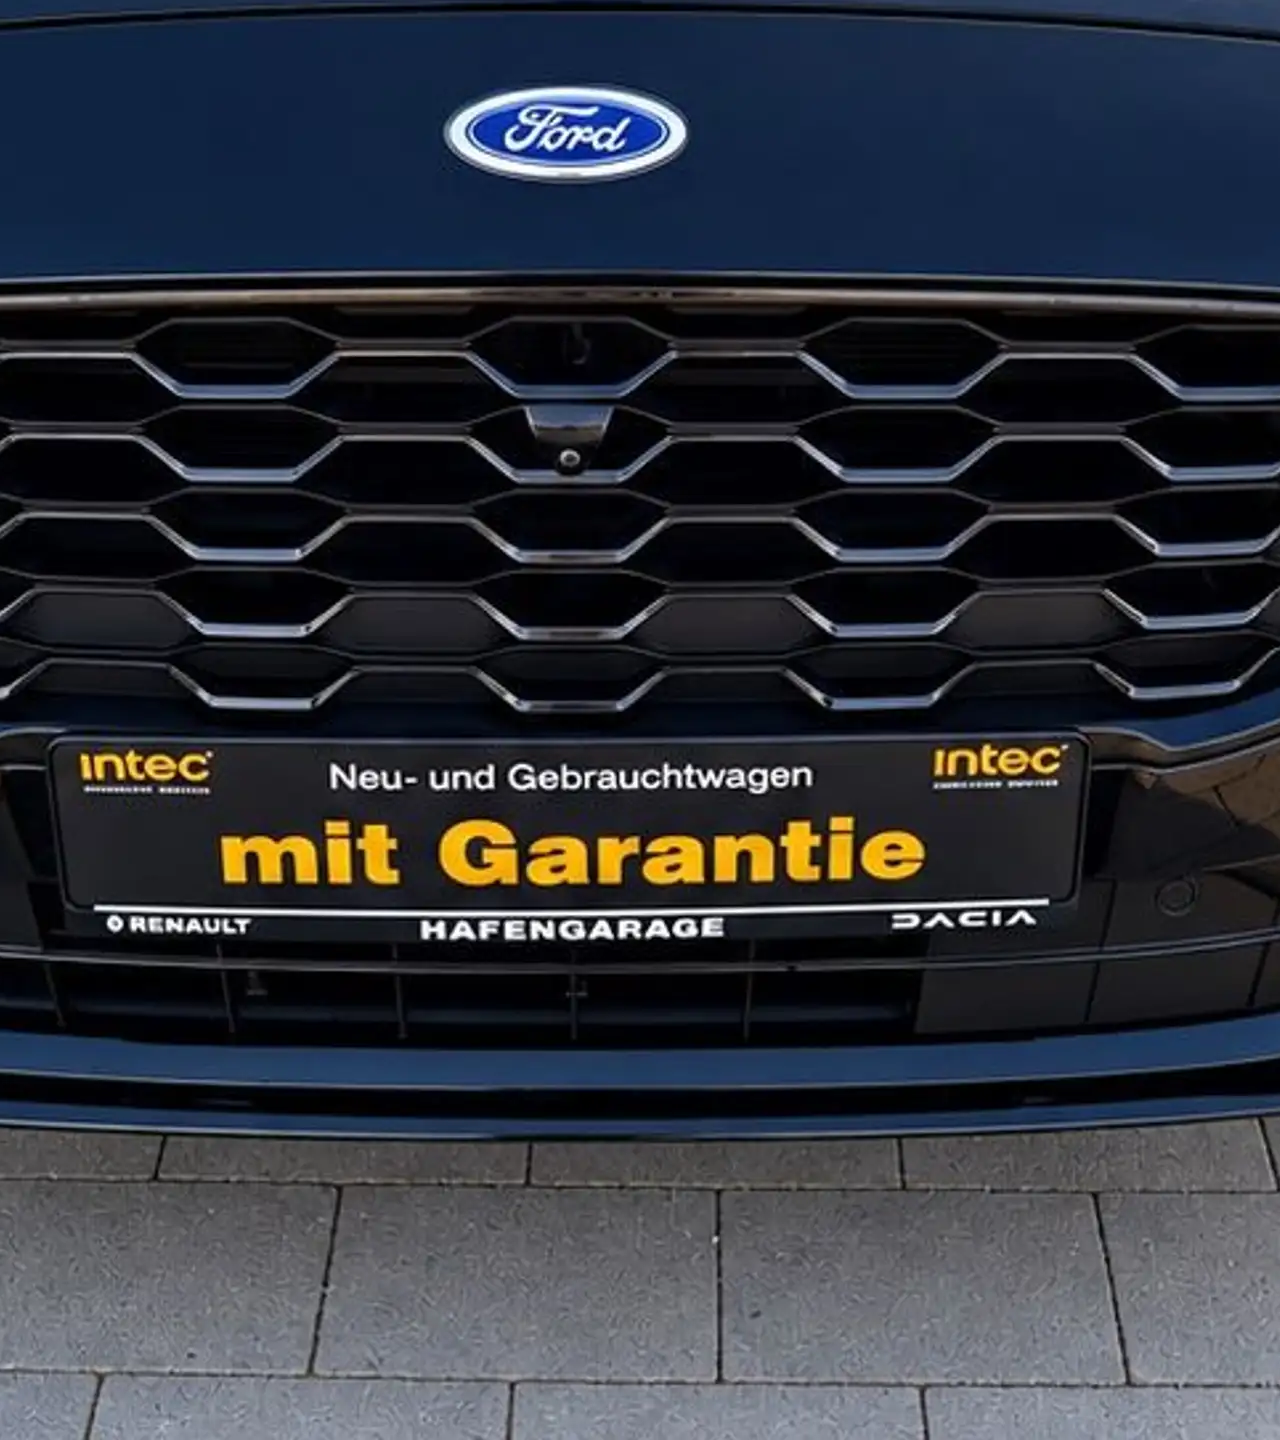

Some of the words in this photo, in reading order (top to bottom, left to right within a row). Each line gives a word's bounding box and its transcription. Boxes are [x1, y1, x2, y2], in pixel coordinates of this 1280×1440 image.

[504, 103, 630, 153] Ford
[80, 749, 210, 781] intec
[933, 742, 1062, 776] intec
[329, 763, 417, 791] Neu-
[430, 762, 495, 791] und
[508, 760, 814, 795] Gebrauchtwagen
[219, 819, 401, 886] mit
[437, 816, 927, 888] Garantie
[130, 916, 252, 935] RENAULT
[420, 918, 725, 941] HAFENGARAGE
[891, 909, 1037, 930] DACIA
